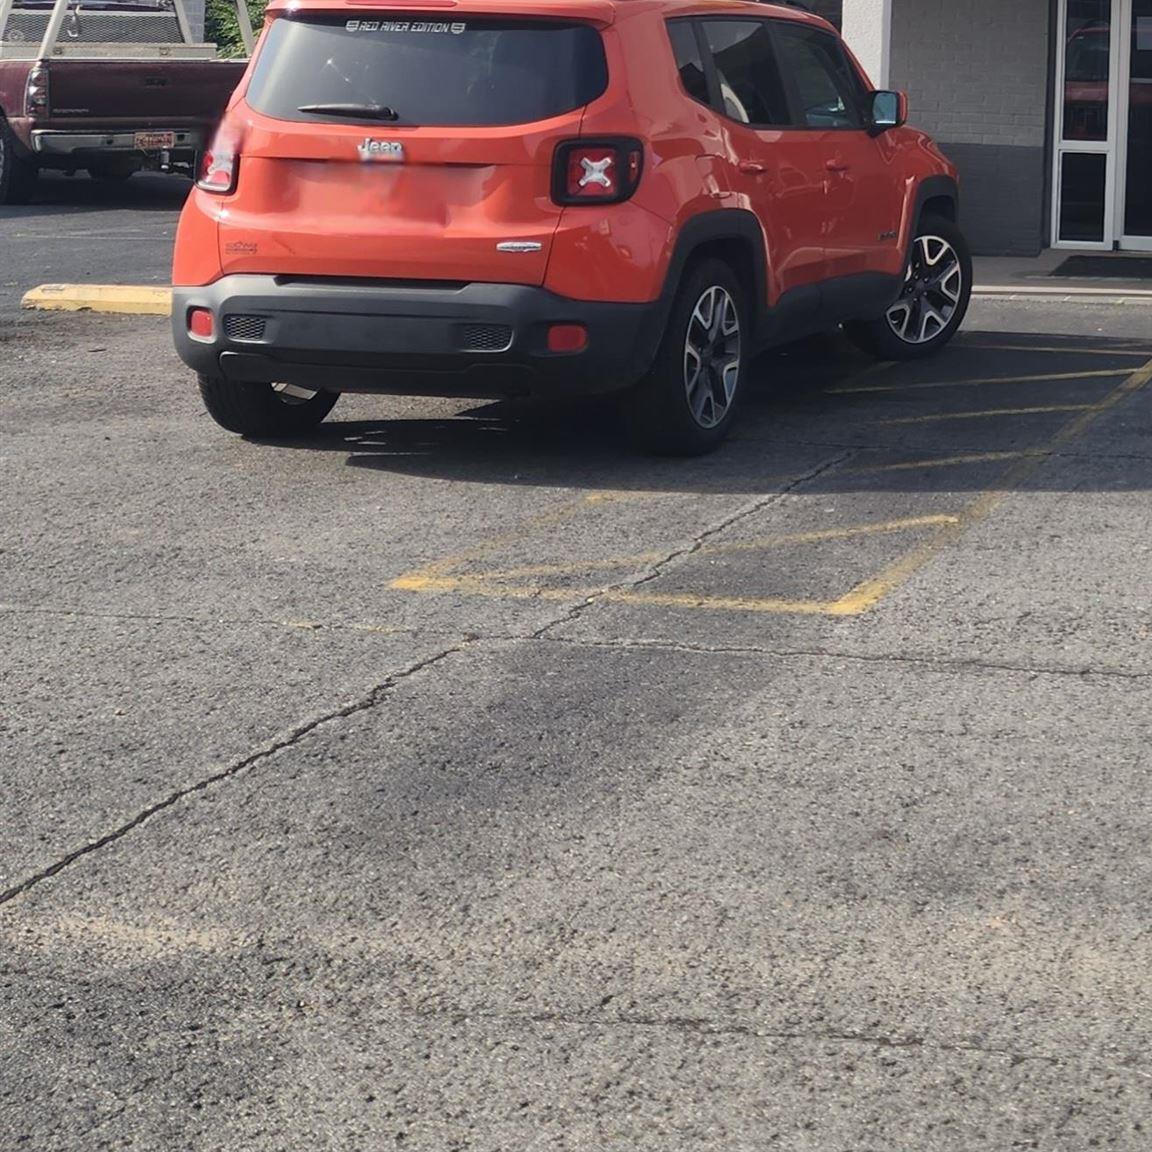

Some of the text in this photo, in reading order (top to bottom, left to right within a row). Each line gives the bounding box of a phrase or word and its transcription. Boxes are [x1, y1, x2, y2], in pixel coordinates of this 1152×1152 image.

[358, 21, 449, 33] RED RIVER EDITION
